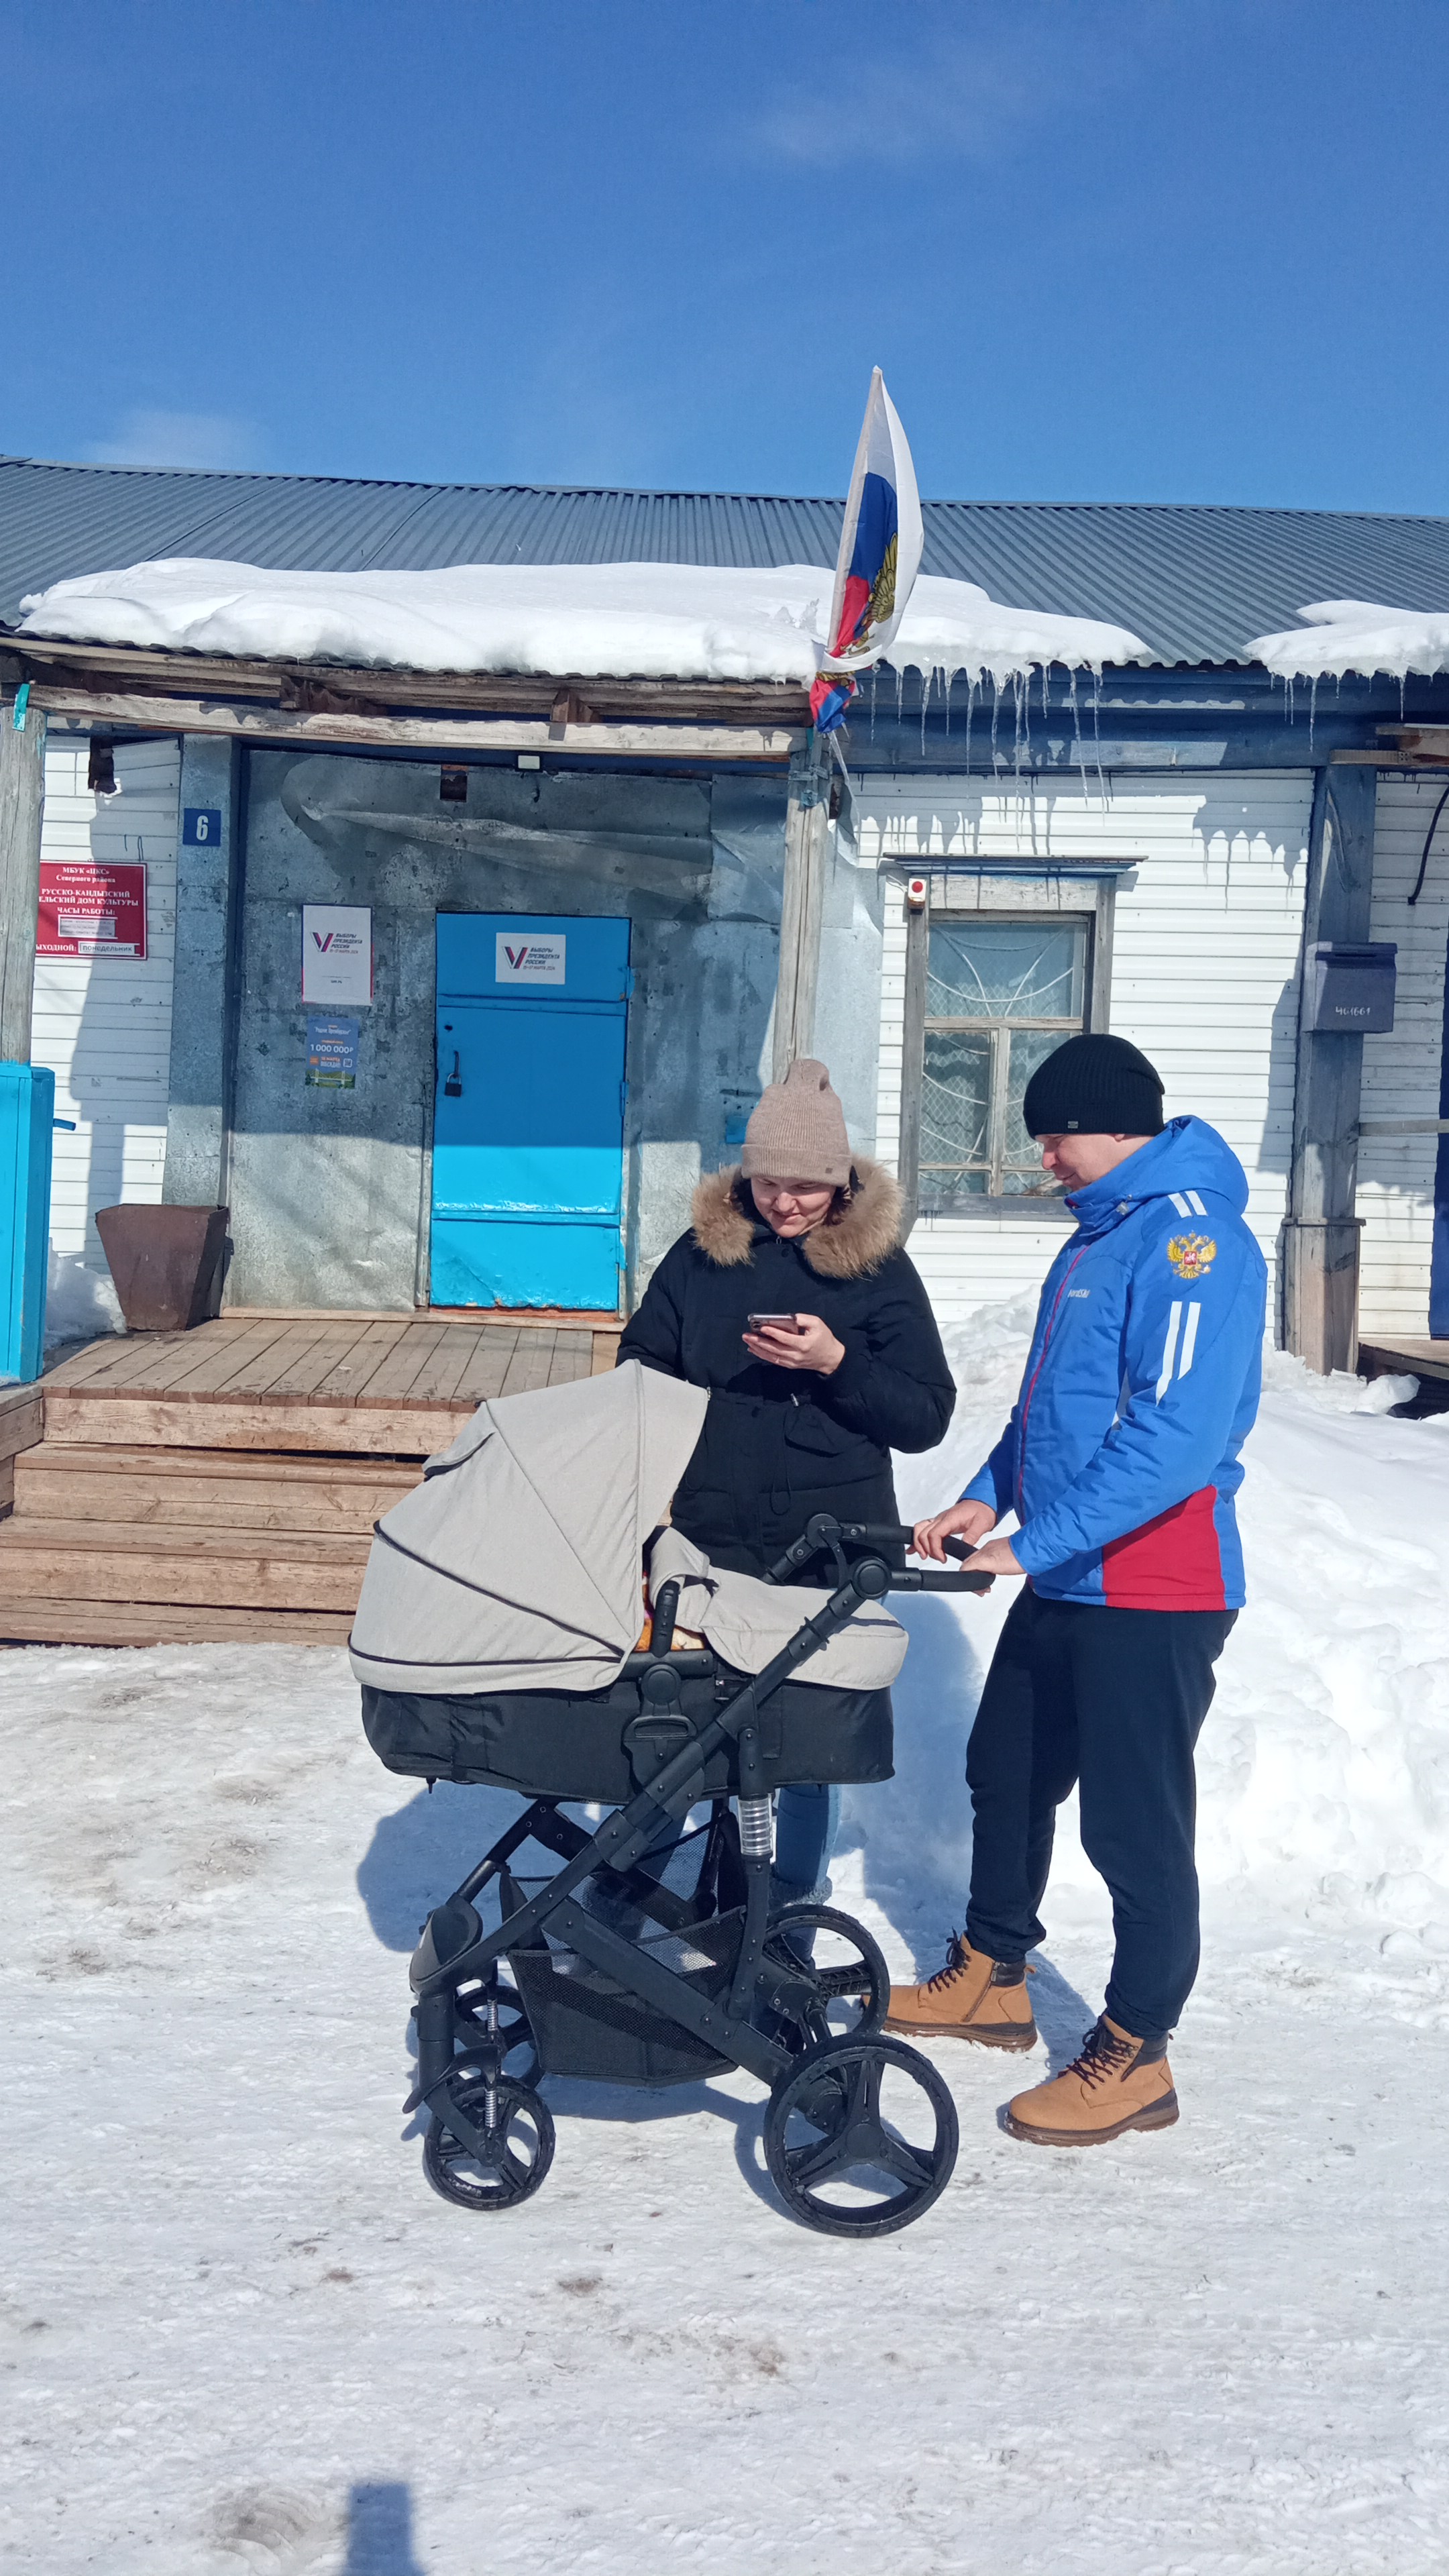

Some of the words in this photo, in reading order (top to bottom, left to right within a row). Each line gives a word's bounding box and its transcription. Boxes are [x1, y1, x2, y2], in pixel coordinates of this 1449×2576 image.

[196, 815, 209, 841] 6
[56, 875, 91, 883] Северного
[38, 896, 76, 904] ЕЛЬСКИЙ
[97, 898, 138, 906] КУЛЬТУРЫ
[36, 944, 76, 952] ЫХОДНОЙ:
